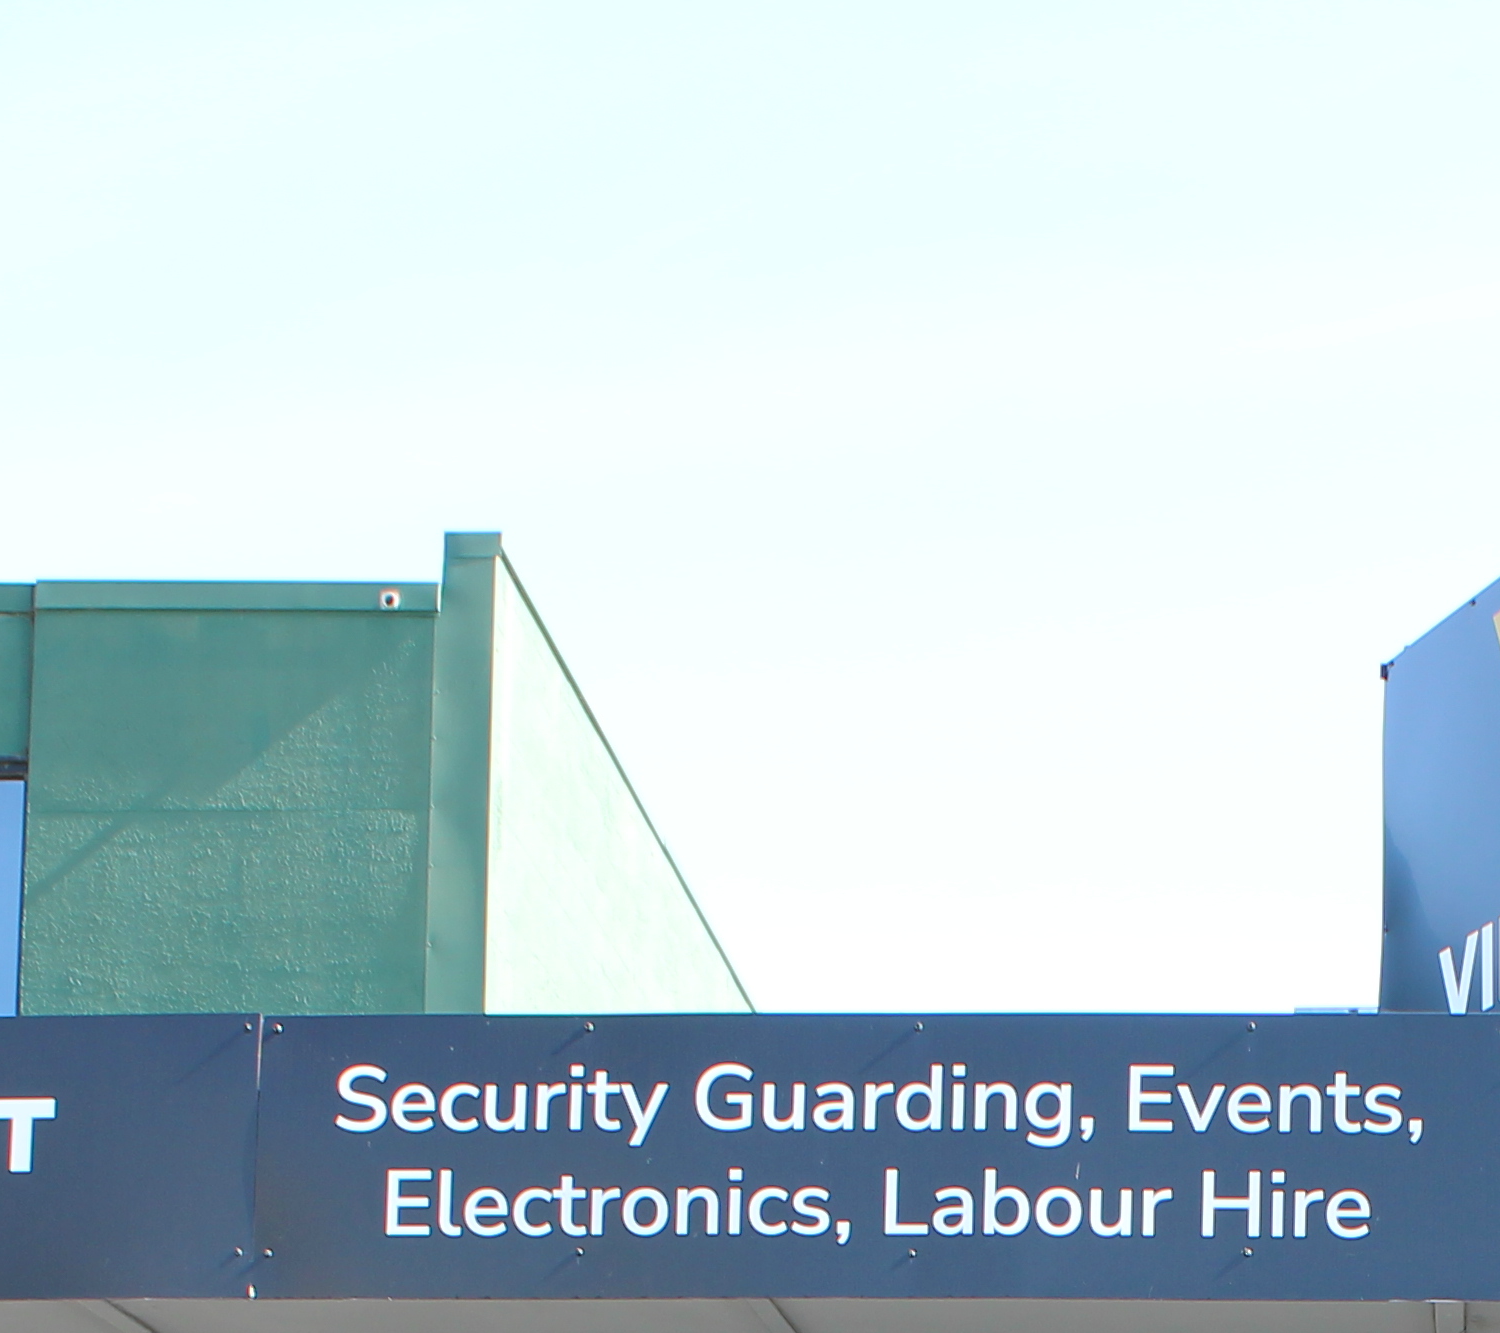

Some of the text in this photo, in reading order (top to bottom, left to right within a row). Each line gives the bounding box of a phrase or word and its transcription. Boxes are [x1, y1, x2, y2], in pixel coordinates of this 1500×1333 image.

[335, 1062, 1426, 1147] Security Guarding, Events,
[383, 1167, 1373, 1244] Electronics, Labour Hire
